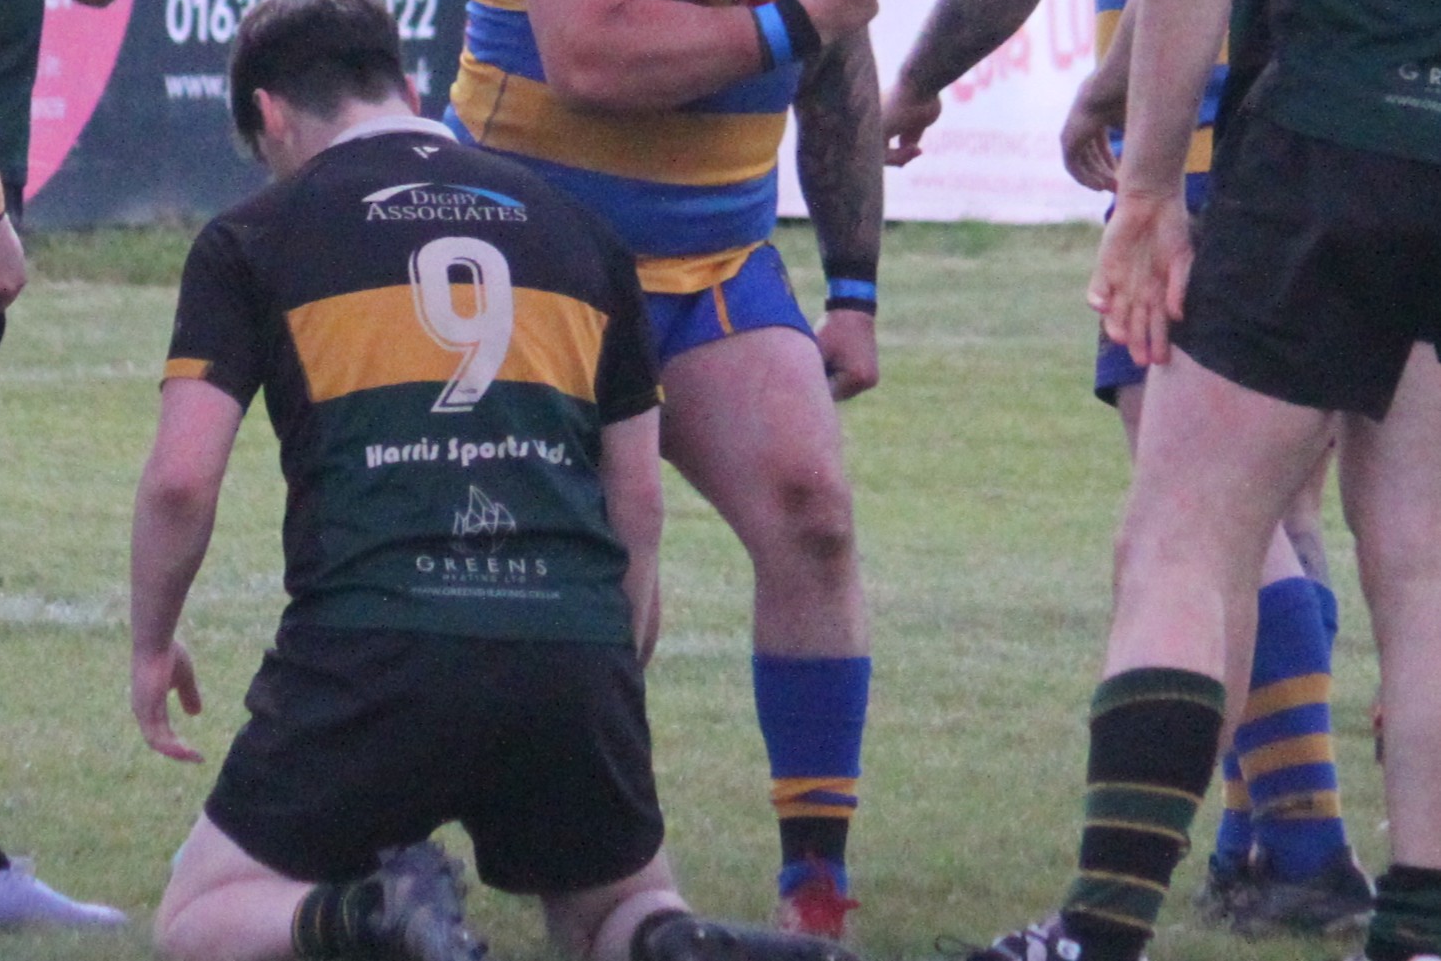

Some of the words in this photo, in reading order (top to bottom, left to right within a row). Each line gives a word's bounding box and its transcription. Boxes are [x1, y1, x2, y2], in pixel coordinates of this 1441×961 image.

[366, 203, 528, 222] ASSOCIATES
[409, 237, 514, 413] 9
[365, 437, 439, 468] Harris
[447, 435, 529, 467] Sports
[416, 555, 547, 576] GREENS
